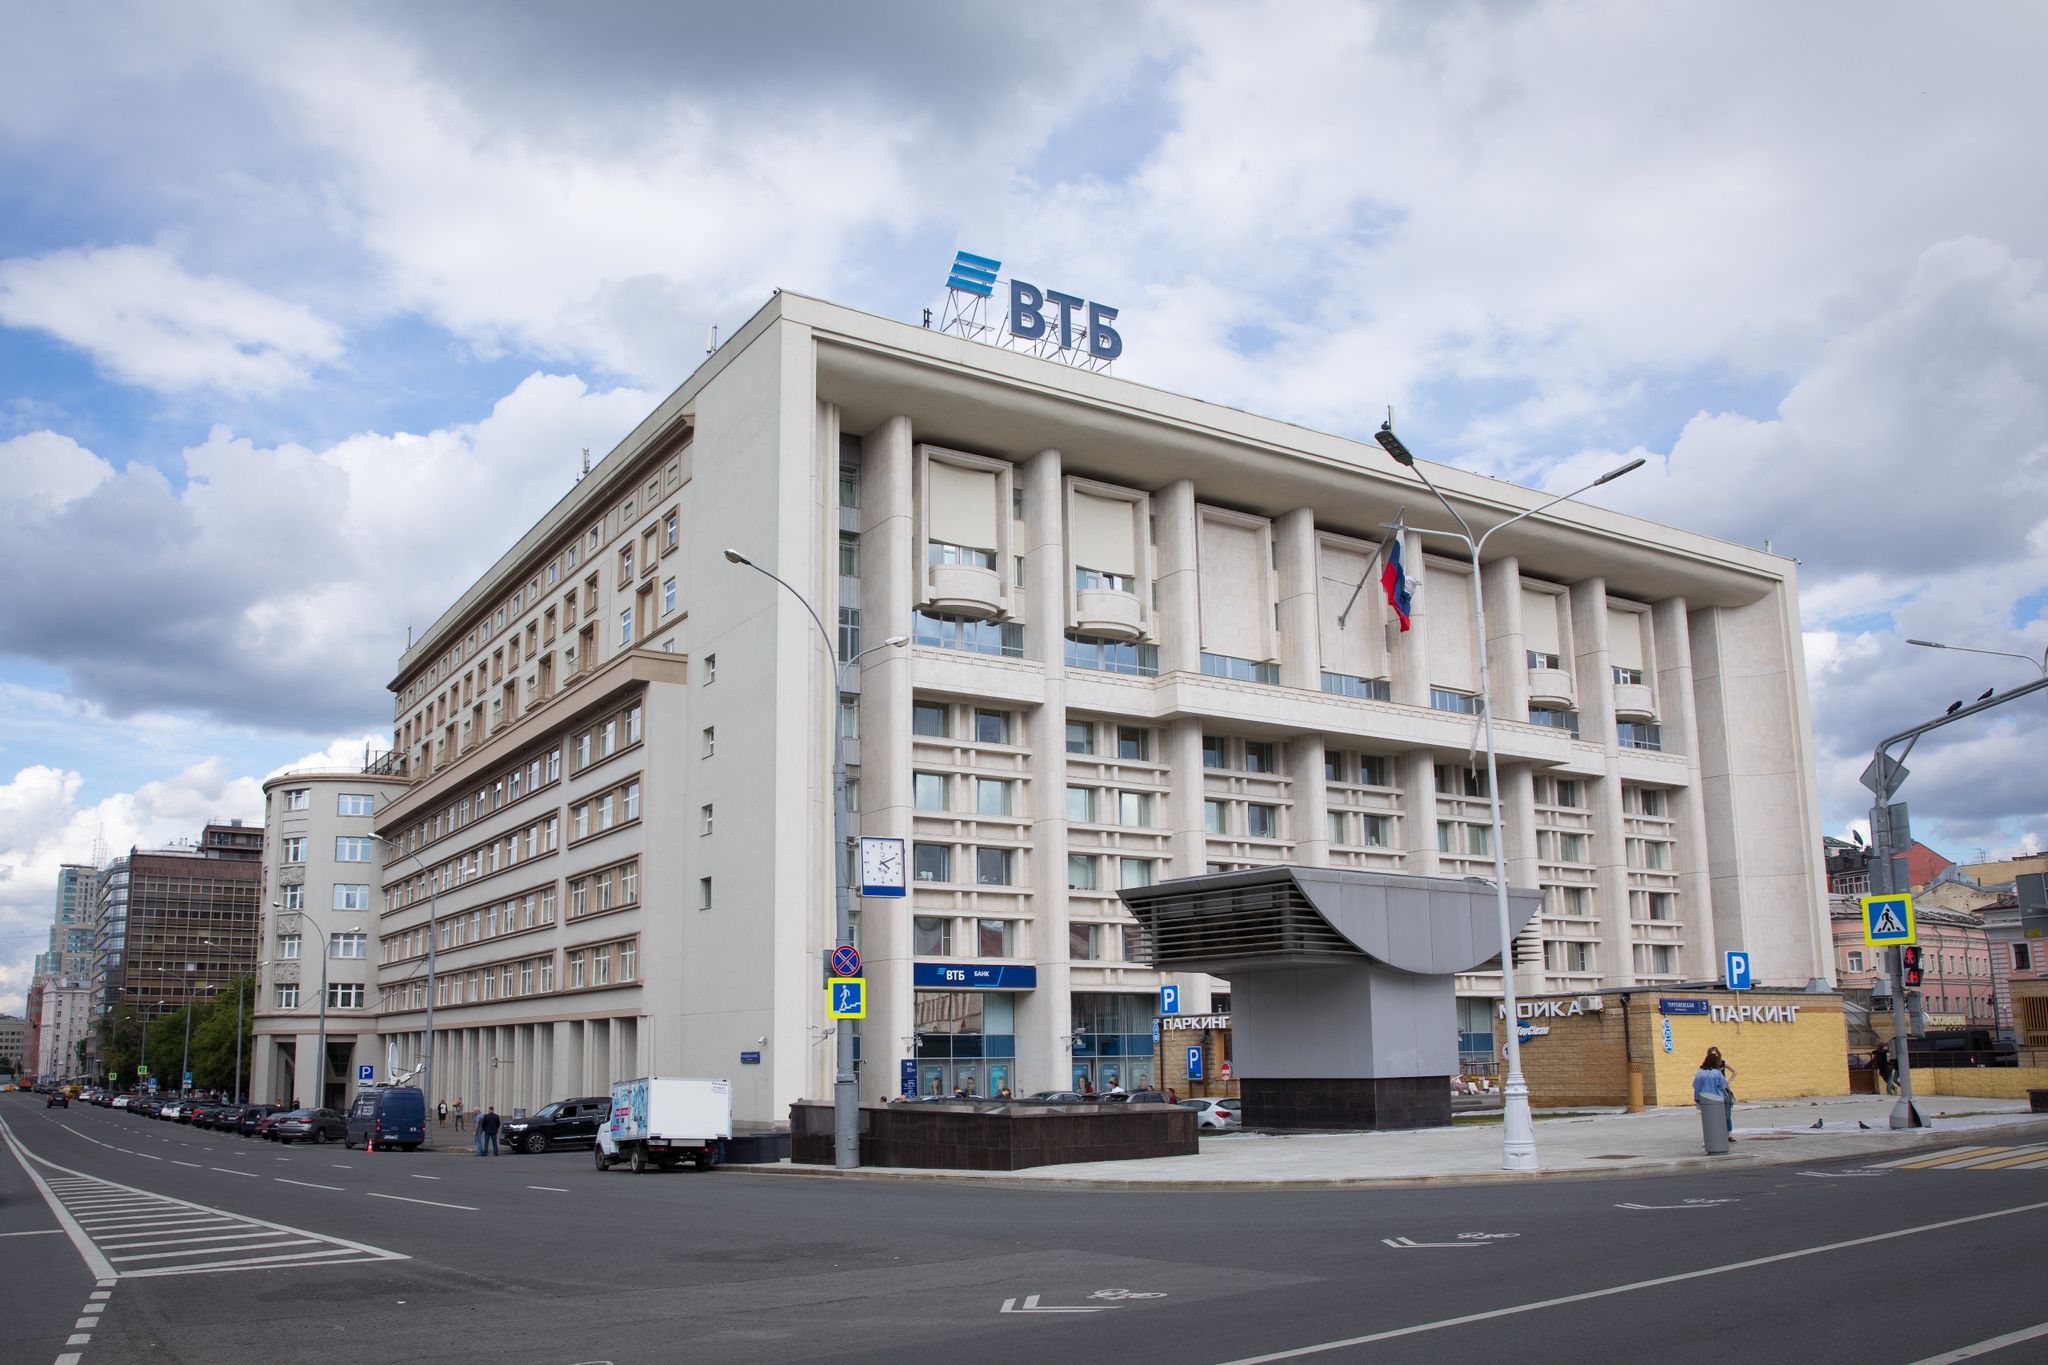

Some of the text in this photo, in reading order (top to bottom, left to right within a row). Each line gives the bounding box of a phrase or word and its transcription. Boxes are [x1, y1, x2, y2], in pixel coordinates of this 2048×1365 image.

[1008, 278, 1123, 361] ВТБ
[946, 970, 965, 981] ВТБ
[1731, 955, 1746, 985] P
[1163, 988, 1175, 1011] P
[1163, 1016, 1230, 1031] ПАРКИНГ
[1711, 1004, 1800, 1024] ПАРКИНГ
[1189, 1049, 1199, 1069] P
[362, 1067, 371, 1079] P
